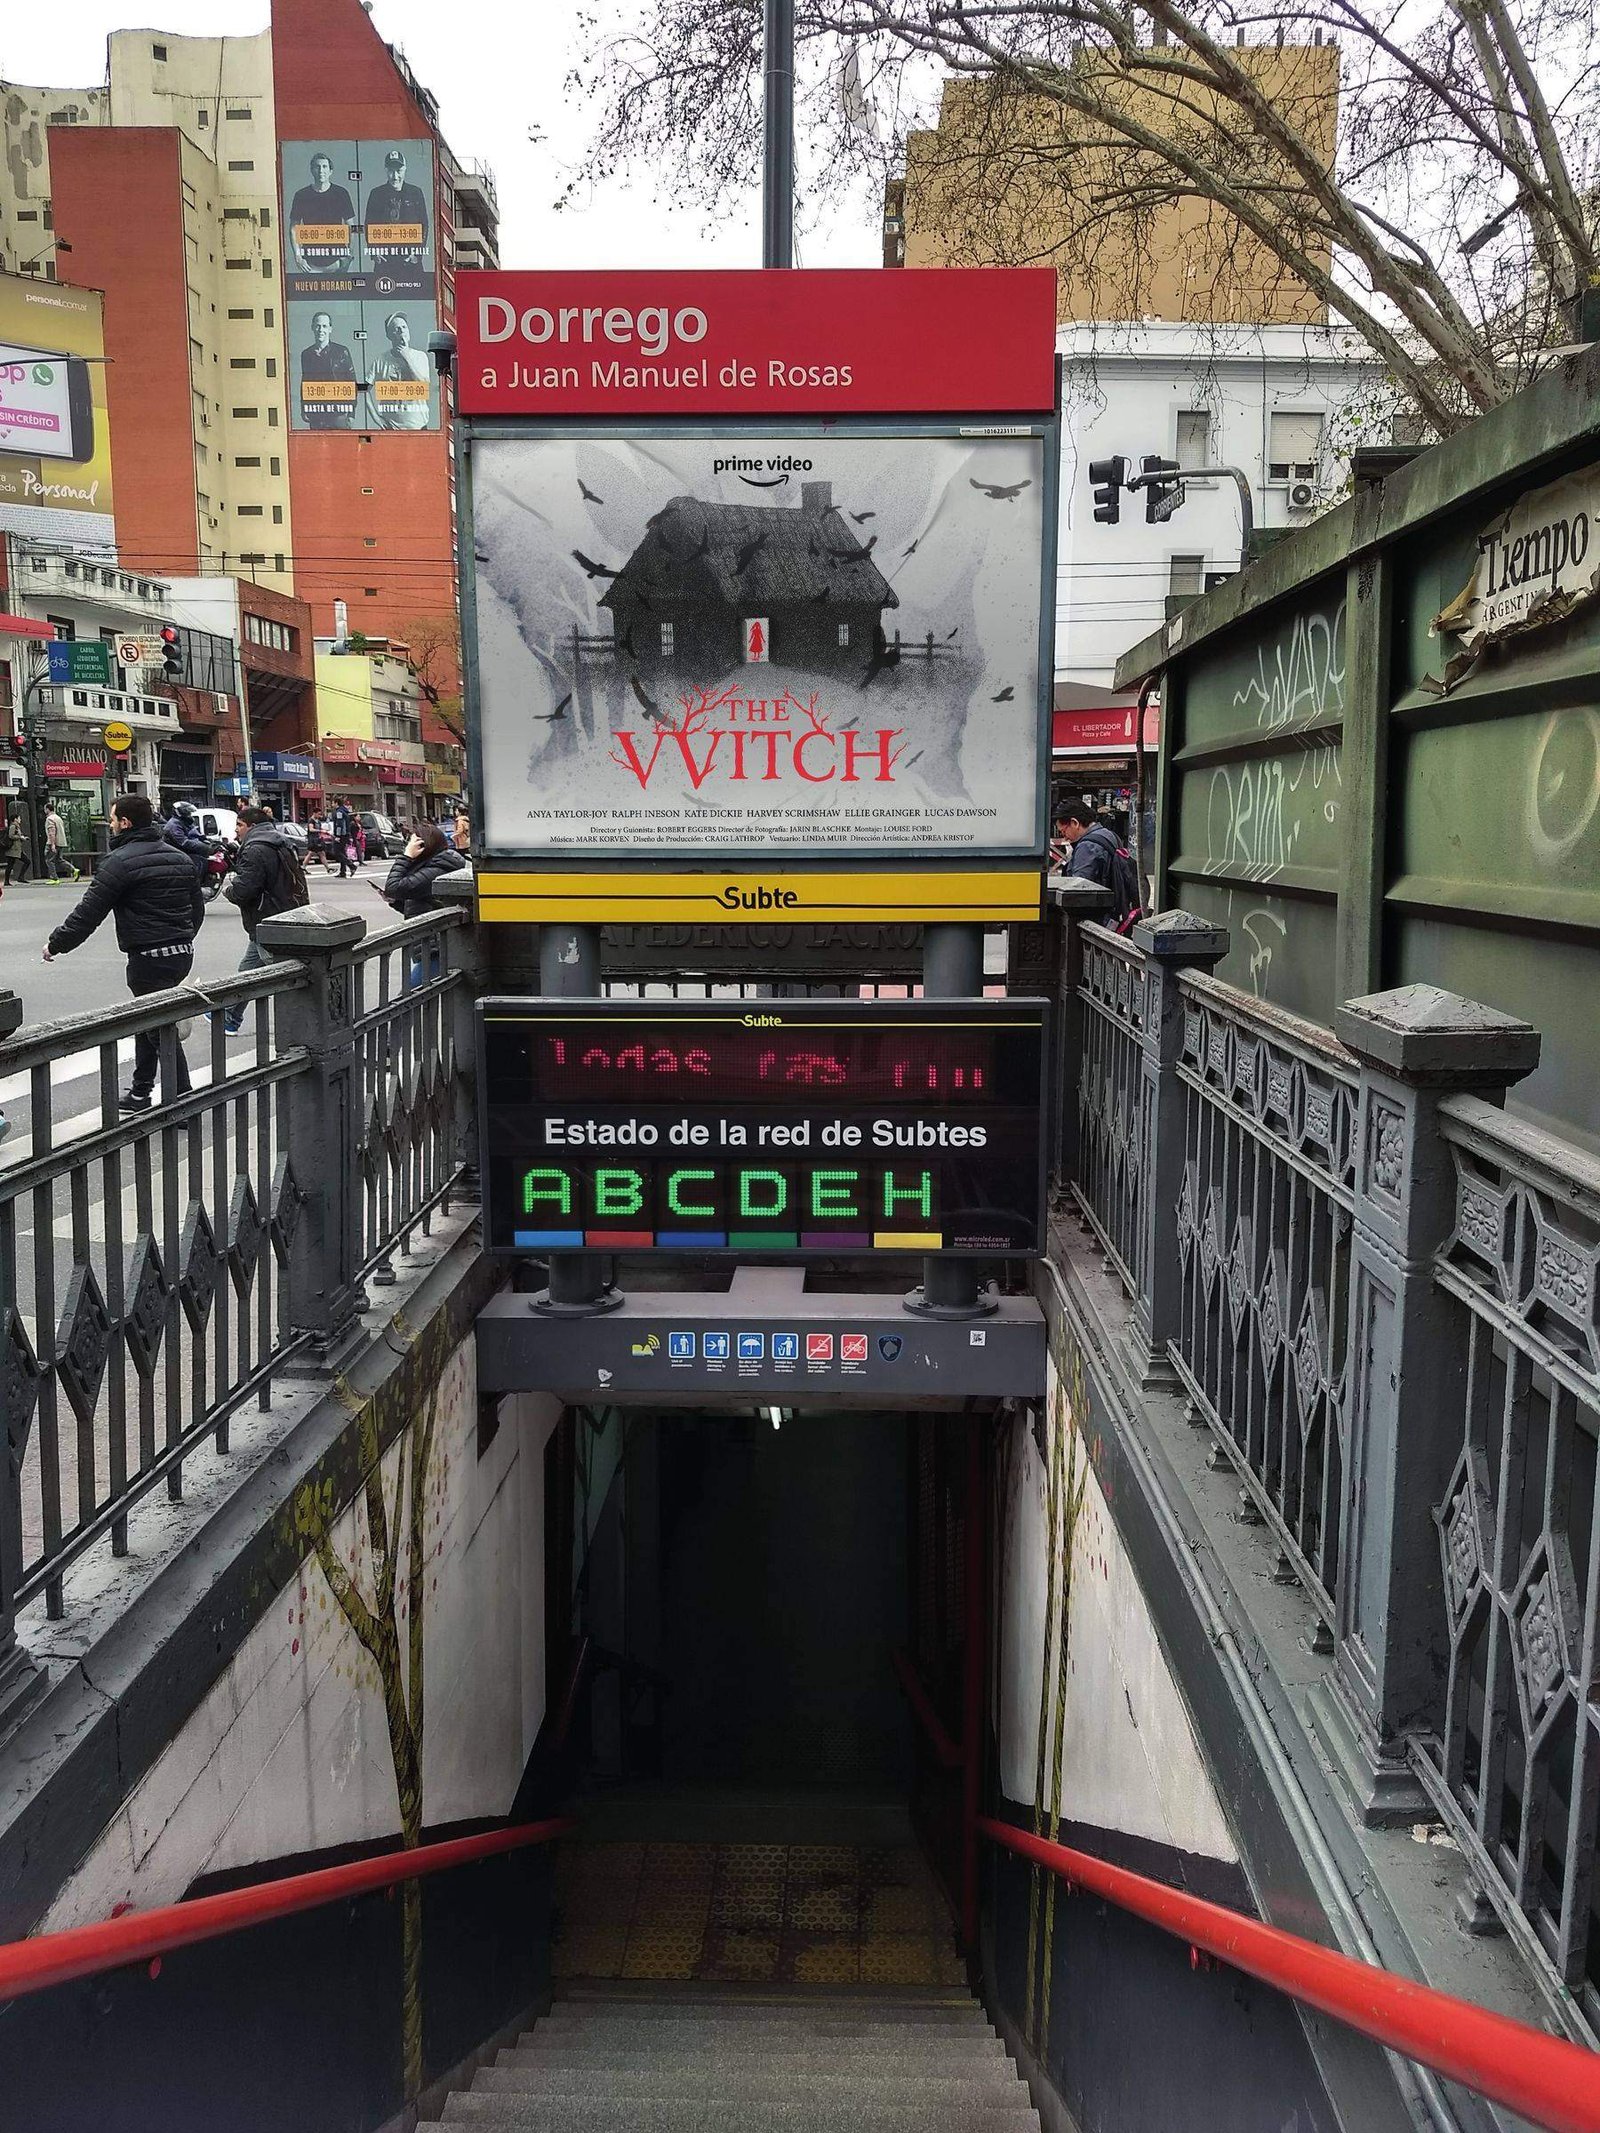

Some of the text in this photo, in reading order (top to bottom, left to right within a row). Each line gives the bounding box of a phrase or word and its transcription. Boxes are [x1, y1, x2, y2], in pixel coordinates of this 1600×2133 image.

[295, 280, 352, 292] NUEVO HORARIO
[478, 296, 709, 358] Dorrego
[480, 359, 854, 389] a Juan Manuel de Rosas
[306, 386, 326, 396] 13:00
[332, 386, 352, 396] 17:00
[16, 412, 54, 427] CRÉDITO
[713, 455, 813, 475] prime video
[20, 469, 99, 507] Personal
[1477, 512, 1590, 599] Tiempo
[724, 699, 790, 722] THE
[107, 731, 128, 739] Subte
[1082, 724, 1122, 732] LIBERTADOR
[62, 747, 108, 764] ARMANO
[527, 808, 998, 819] ANYA TAYLOR-JOY RALPH INESON KATE DICKIE HARVEY SCRIMSHAW ELLIE GRAINGER LUCAS DAWSON
[754, 826, 788, 834] Fotografía:
[854, 826, 882, 834] Montaje:
[723, 886, 798, 910] Subte
[805, 923, 924, 950] LACRO
[744, 1014, 782, 1028] Subte
[544, 1118, 988, 1148] Estado de la red de Subtes
[522, 1168, 931, 1218] A B C D E H
